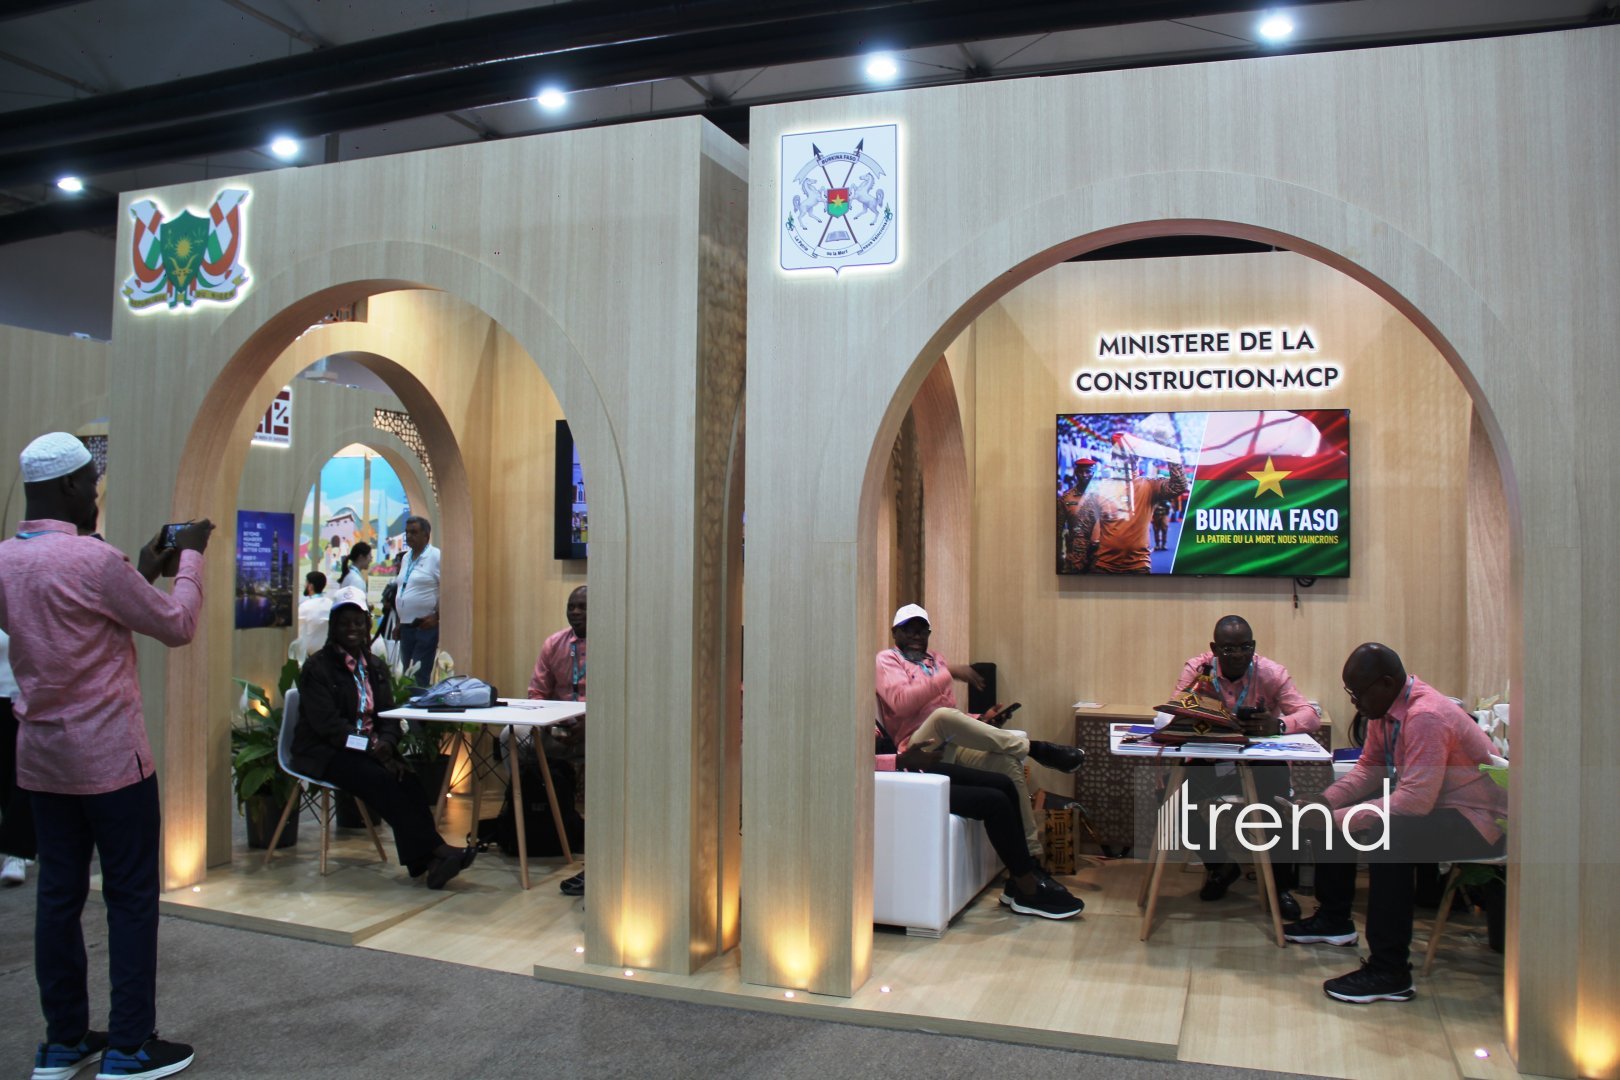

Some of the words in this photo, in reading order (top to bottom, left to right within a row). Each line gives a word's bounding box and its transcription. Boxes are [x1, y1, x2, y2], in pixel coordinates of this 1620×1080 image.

[821, 155, 843, 164] BURKINA
[843, 154, 857, 162] FASO
[1099, 332, 1230, 355] MINISTERE
[1240, 331, 1272, 351] DE
[1282, 330, 1314, 350] LA
[1076, 367, 1339, 391] CONSTRUCTION-MCP
[1196, 508, 1283, 531] BURKINA
[1290, 508, 1339, 531] FASO
[1196, 535, 1206, 544] LA
[1207, 535, 1231, 544] PATRIE
[1233, 535, 1243, 544] OU
[1244, 535, 1254, 544] LA
[1255, 535, 1276, 545] MORT,
[1278, 535, 1297, 544] NOUS
[1298, 535, 1339, 544] VAINCRONS
